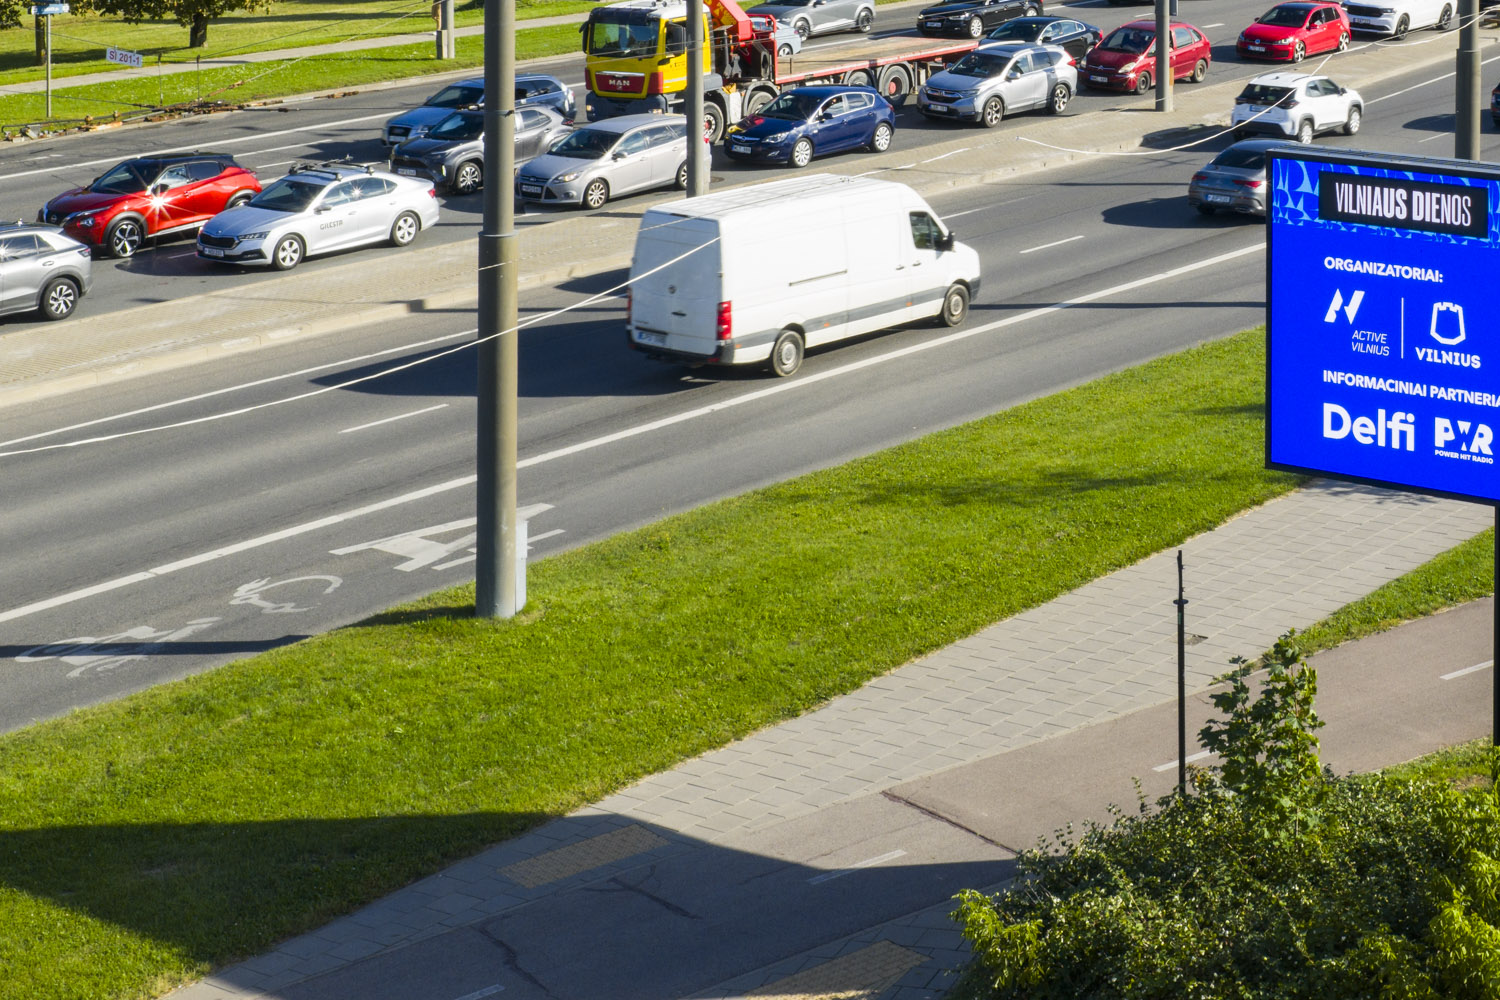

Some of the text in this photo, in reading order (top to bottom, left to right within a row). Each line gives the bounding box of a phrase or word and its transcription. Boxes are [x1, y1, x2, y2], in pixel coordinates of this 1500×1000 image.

[119, 52, 140, 65] 201-1
[608, 79, 631, 87] MAN
[1335, 182, 1472, 227] VILNIAUS DIENOS
[1324, 256, 1443, 283] ORGANIZATORIAI:
[1352, 329, 1388, 344] ACTIVE
[1351, 341, 1390, 357] VILNIUS
[1415, 347, 1481, 369] VILNIUS
[1323, 369, 1427, 398] INFORMACINIAI
[1323, 402, 1415, 452] Delfi
[1434, 449, 1459, 459] POWER
[1472, 455, 1494, 464] RADIO
